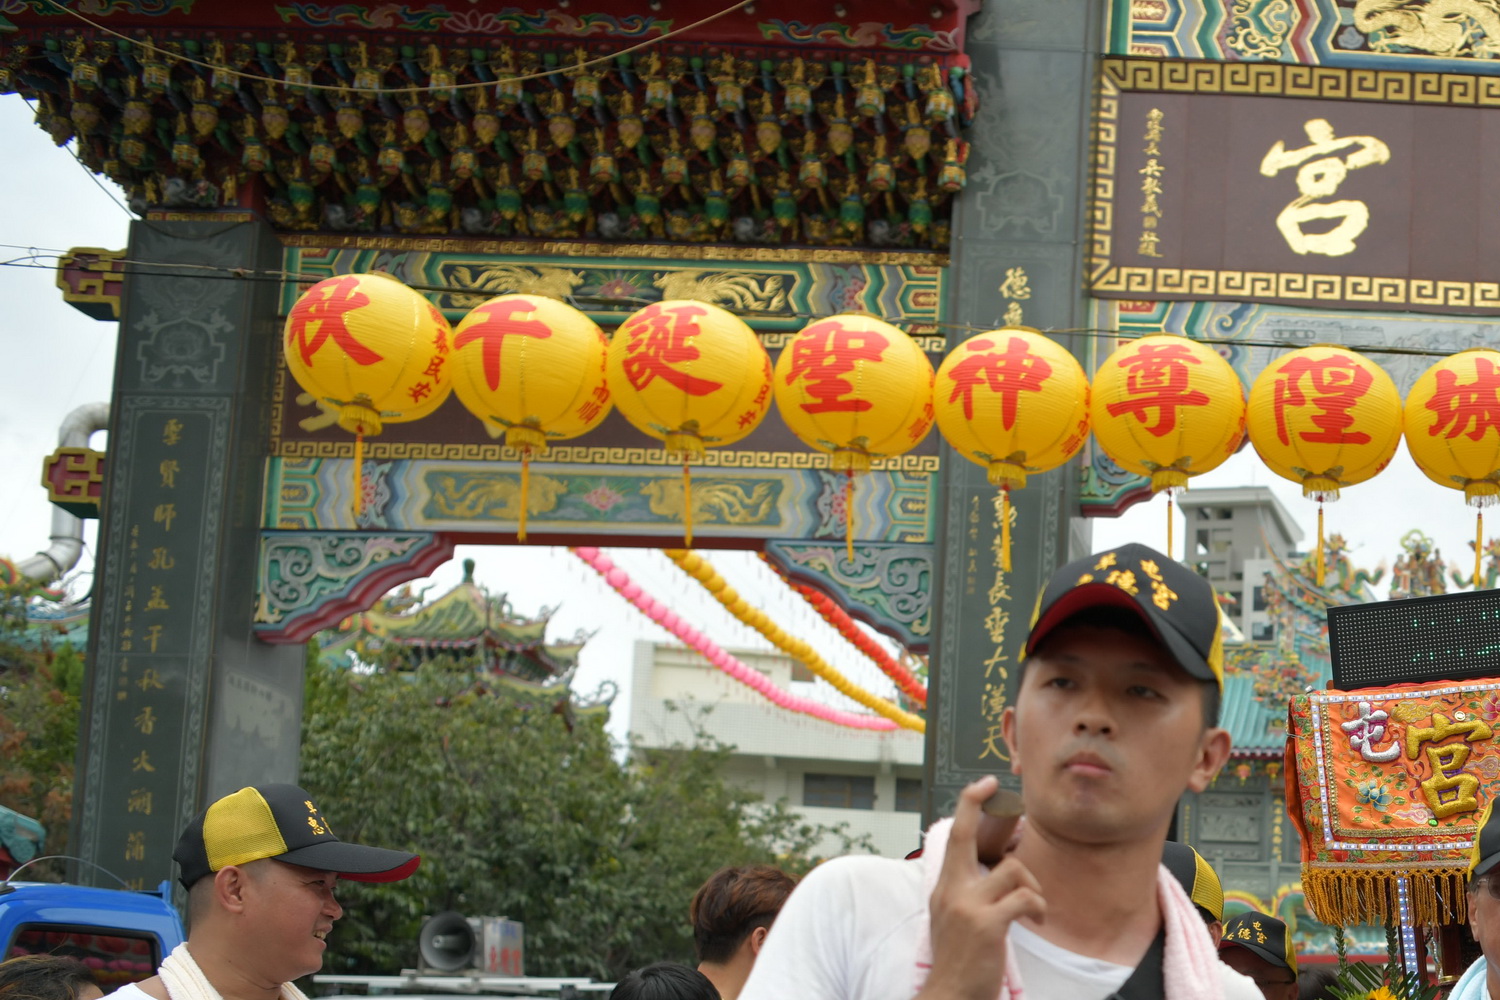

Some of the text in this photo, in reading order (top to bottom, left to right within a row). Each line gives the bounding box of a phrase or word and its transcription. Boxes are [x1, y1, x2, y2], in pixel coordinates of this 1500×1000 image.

[289, 276, 384, 367] 秋
[622, 305, 724, 397] 誕
[785, 321, 891, 415] 聖
[948, 338, 1052, 431] 神
[1106, 344, 1210, 437] 尊
[1274, 355, 1373, 446] 隍
[1341, 701, 1401, 763] 屯
